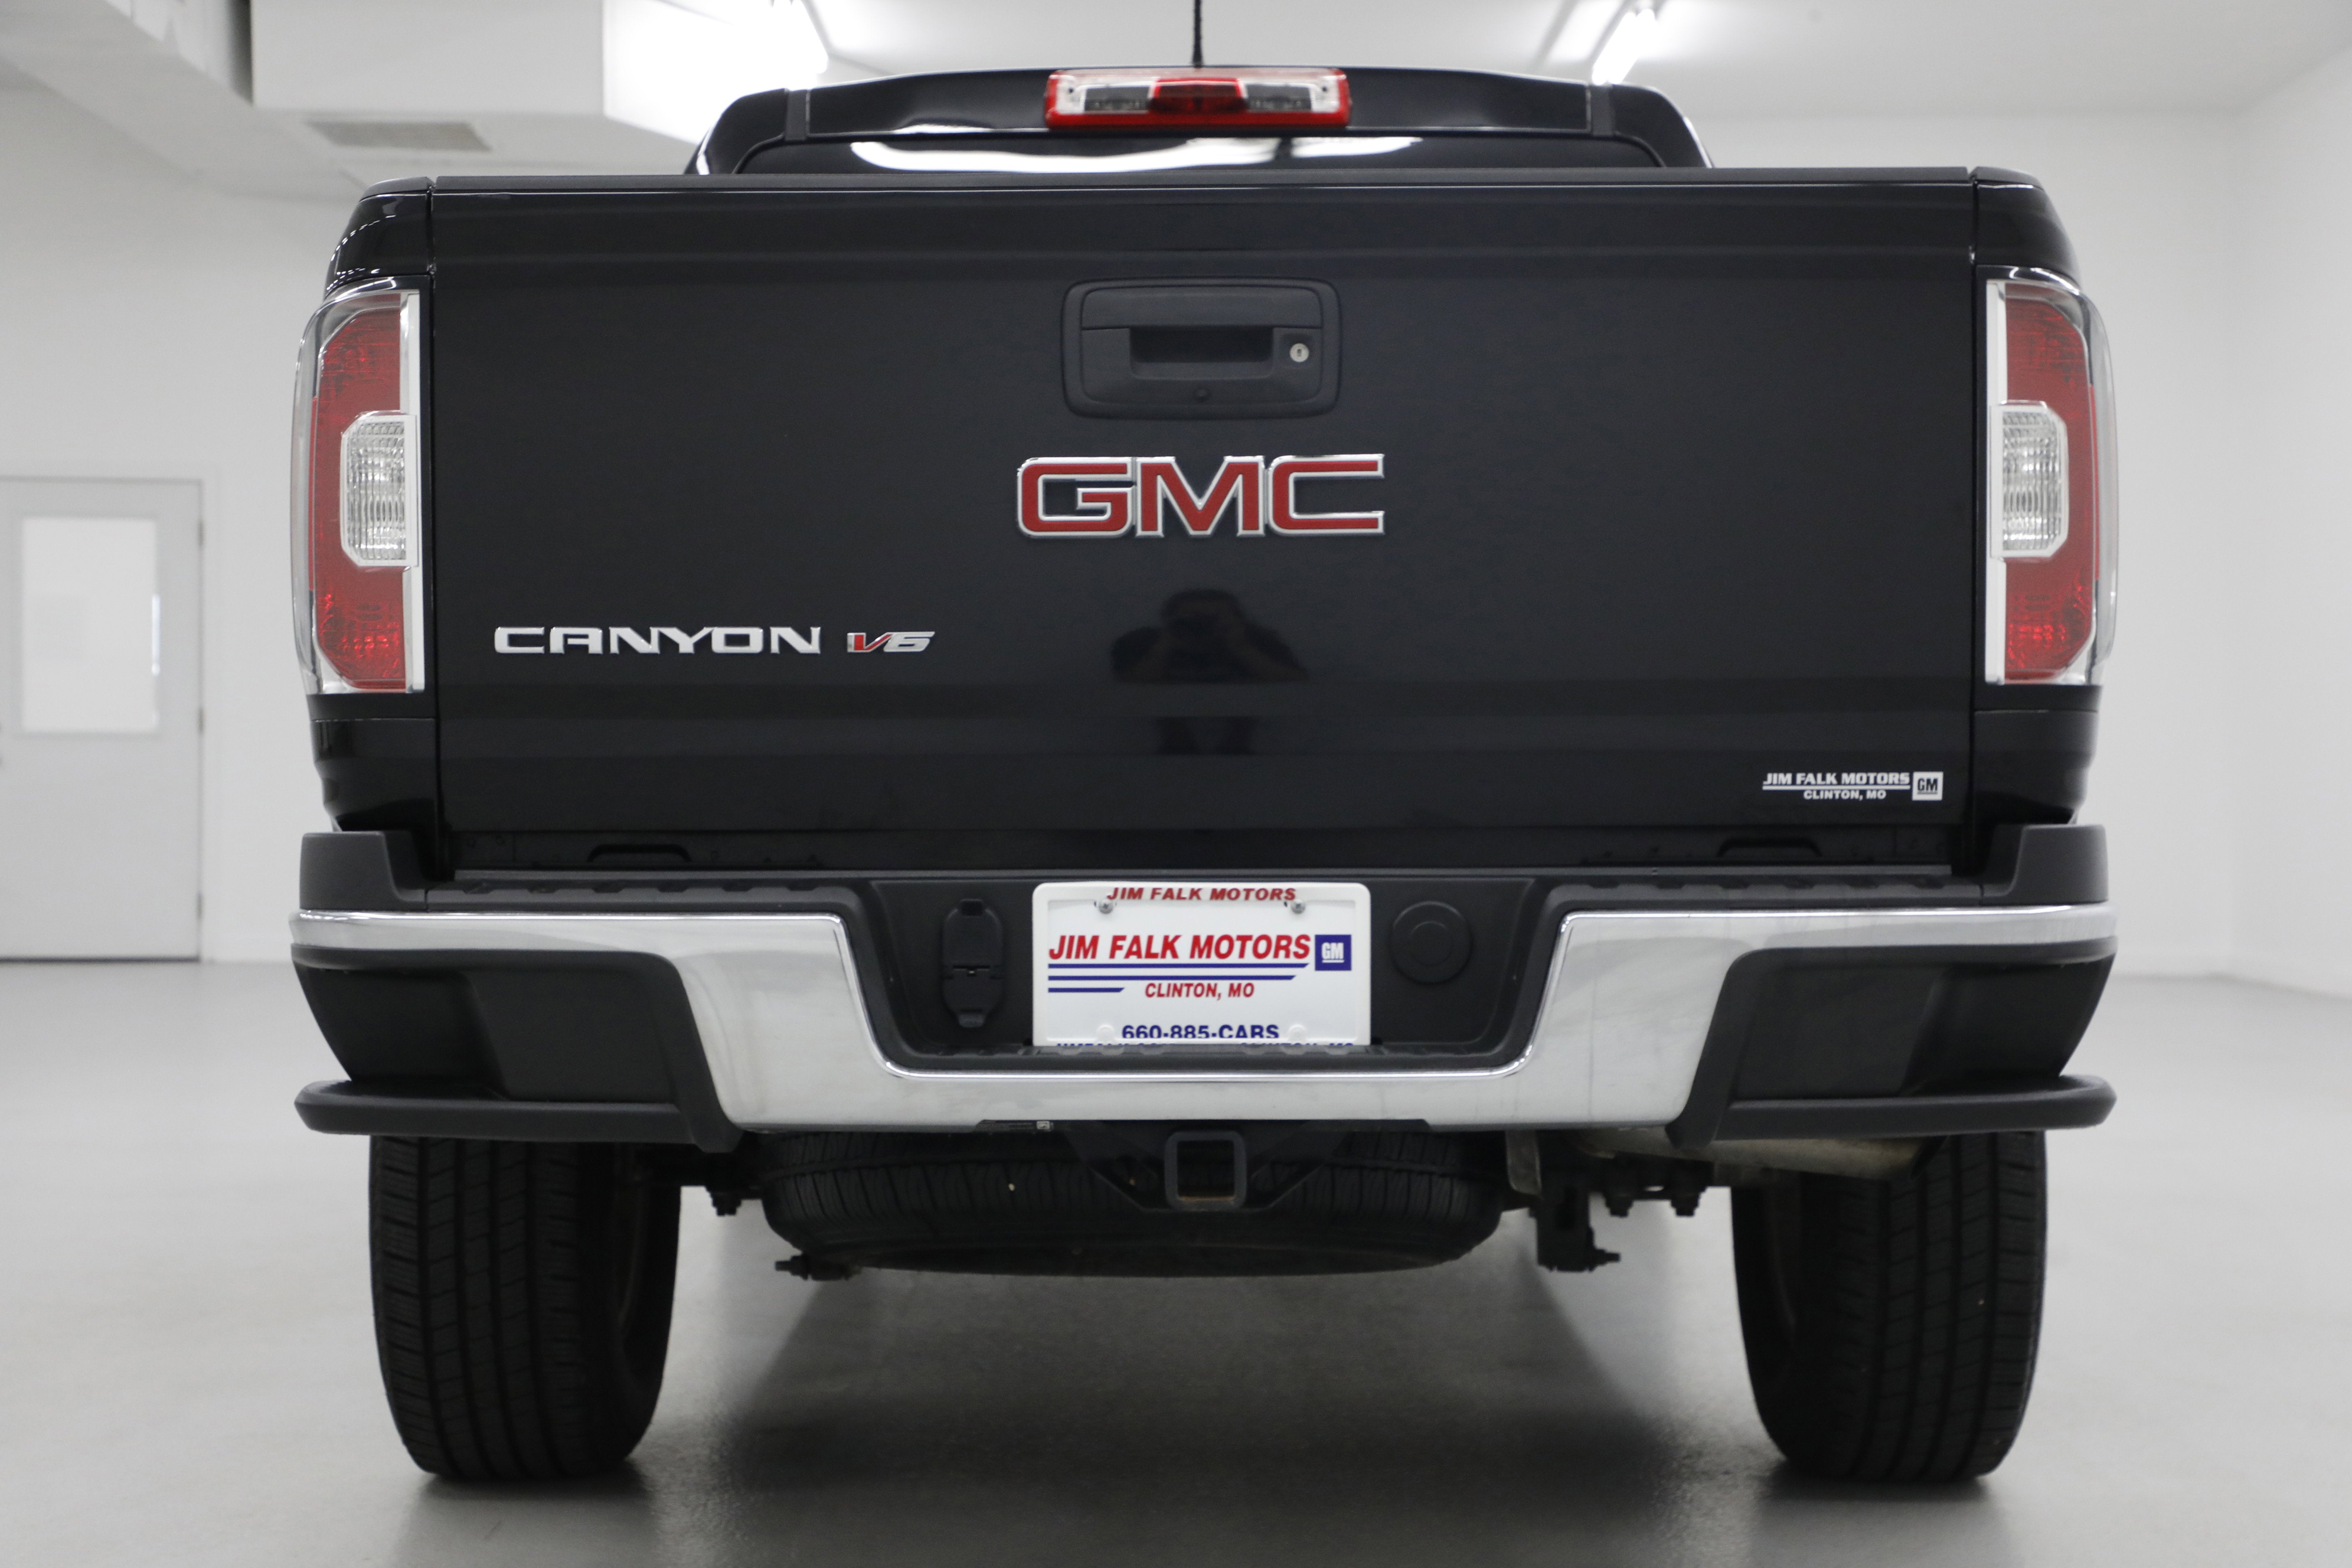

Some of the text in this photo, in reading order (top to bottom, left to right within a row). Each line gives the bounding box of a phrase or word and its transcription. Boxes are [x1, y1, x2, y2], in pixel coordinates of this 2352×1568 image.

[1016, 452, 1385, 538] GMC
[494, 626, 936, 654] CANYON V6
[1763, 772, 1910, 785] JIM FALK MOTORS
[1918, 778, 1938, 795] GM
[1803, 790, 1886, 801] CLINTON, MO
[1107, 887, 1296, 901] JIM FALK MOTORS
[1048, 933, 1311, 960] JIM FALK MOTORS
[1321, 942, 1344, 961] GM
[1145, 982, 1255, 1000] CLINTON, MO
[1121, 1024, 1280, 1039] 660-885-CARS
